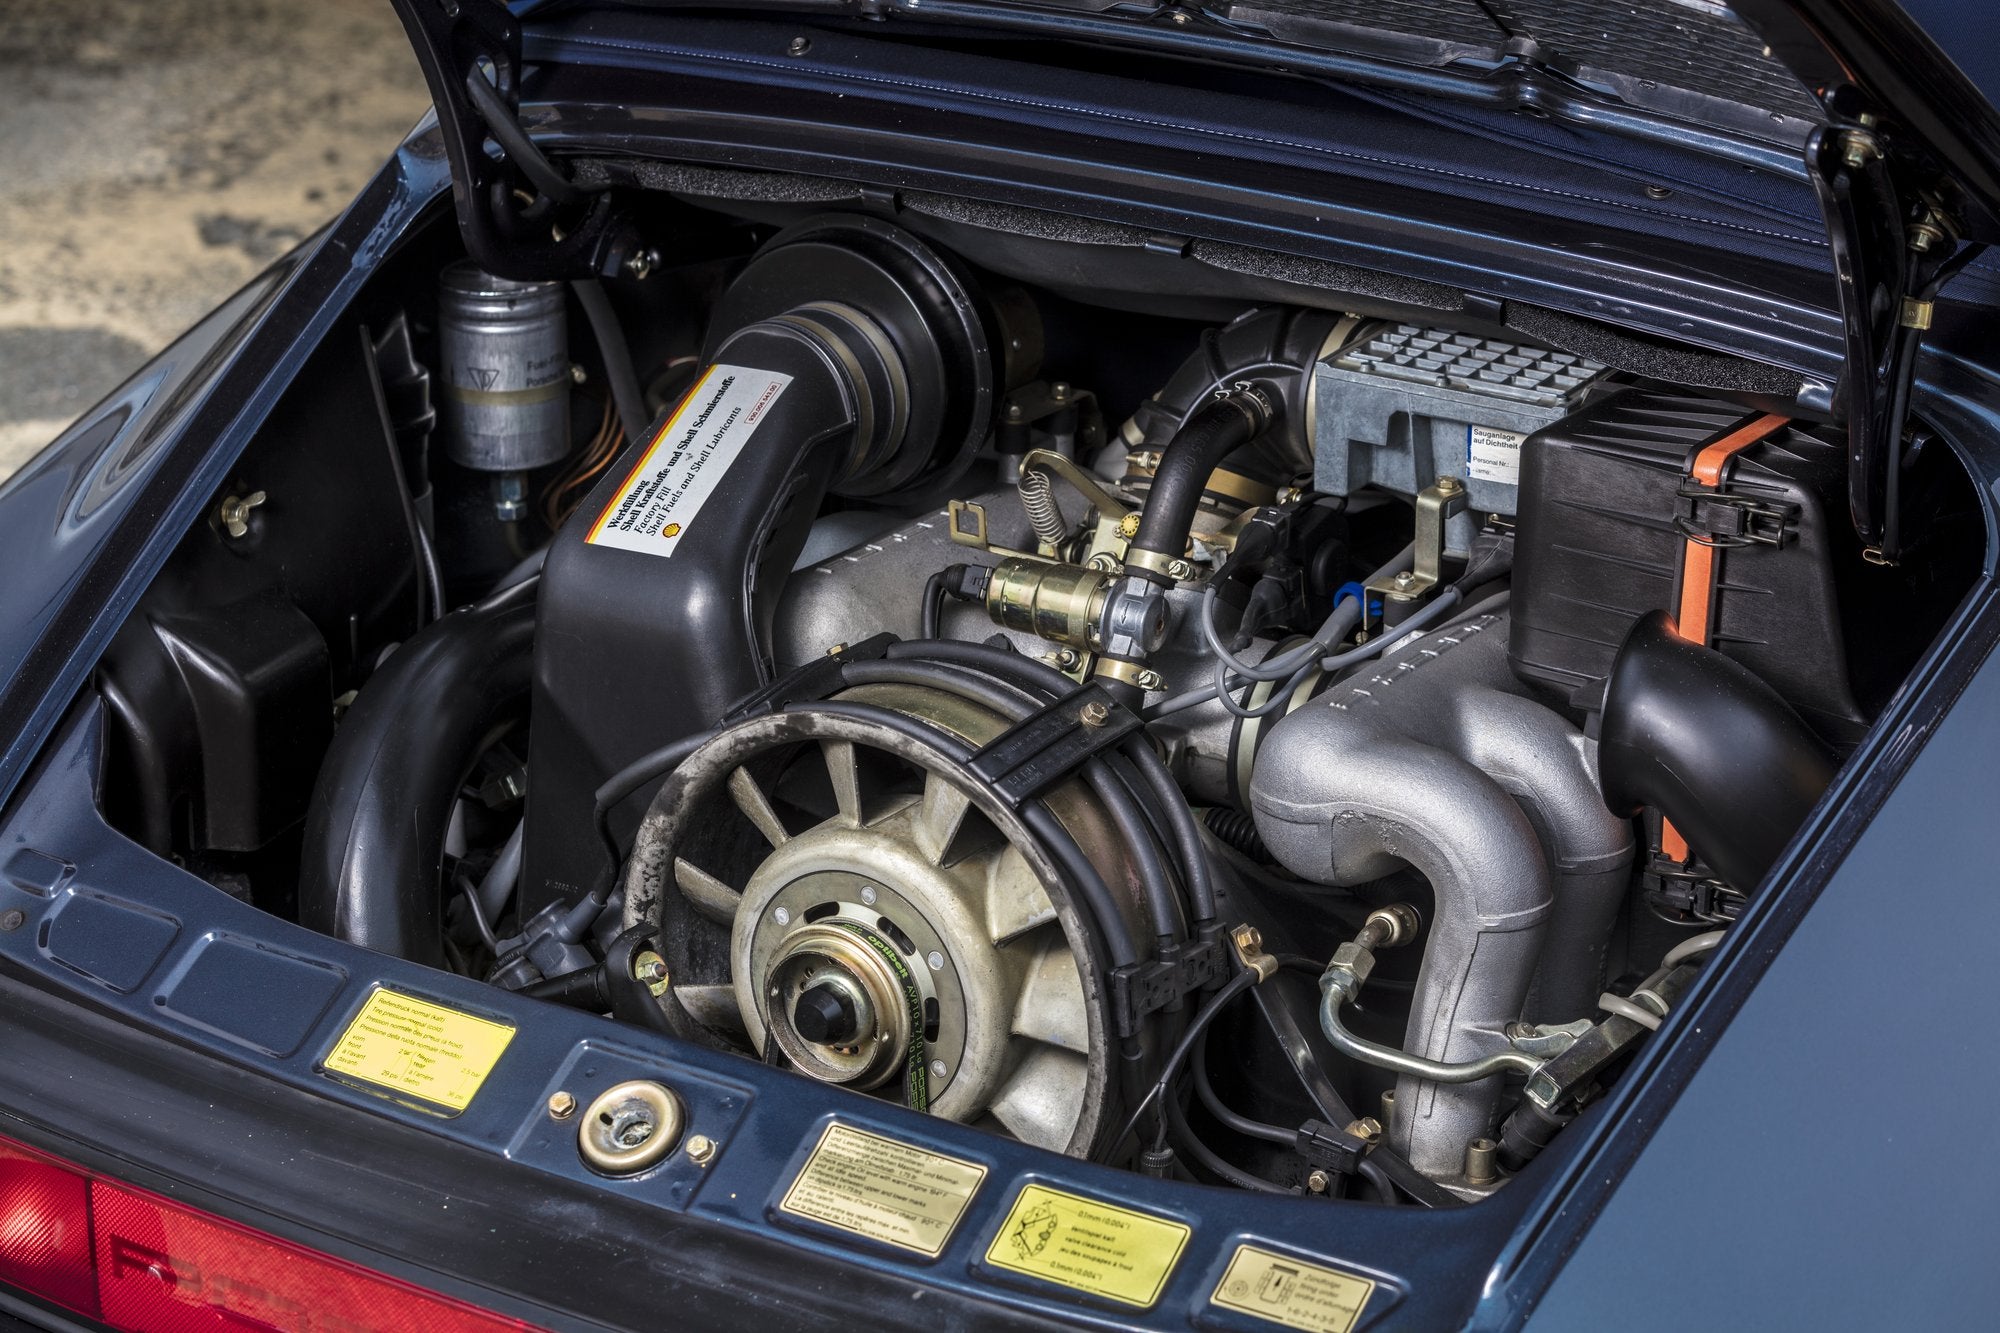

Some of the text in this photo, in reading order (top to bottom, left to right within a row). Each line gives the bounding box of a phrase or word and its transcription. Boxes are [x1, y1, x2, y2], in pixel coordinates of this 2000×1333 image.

[1474, 429, 1515, 442] Sauganlage
[1486, 439, 1518, 449] Dichtheit
[620, 376, 735, 531] Shell Kraftstoffe und Shell Schmierstoffe
[1473, 456, 1498, 465] Personal
[646, 407, 741, 536] Shell Fuels and Shell Lubricants
[607, 480, 650, 528] Werkfüllung
[634, 486, 671, 533] Factory Fill
[868, 935, 908, 978] optibelt
[411, 1009, 431, 1018] normal
[365, 1015, 389, 1026] Pression
[359, 1023, 386, 1035] Pressione
